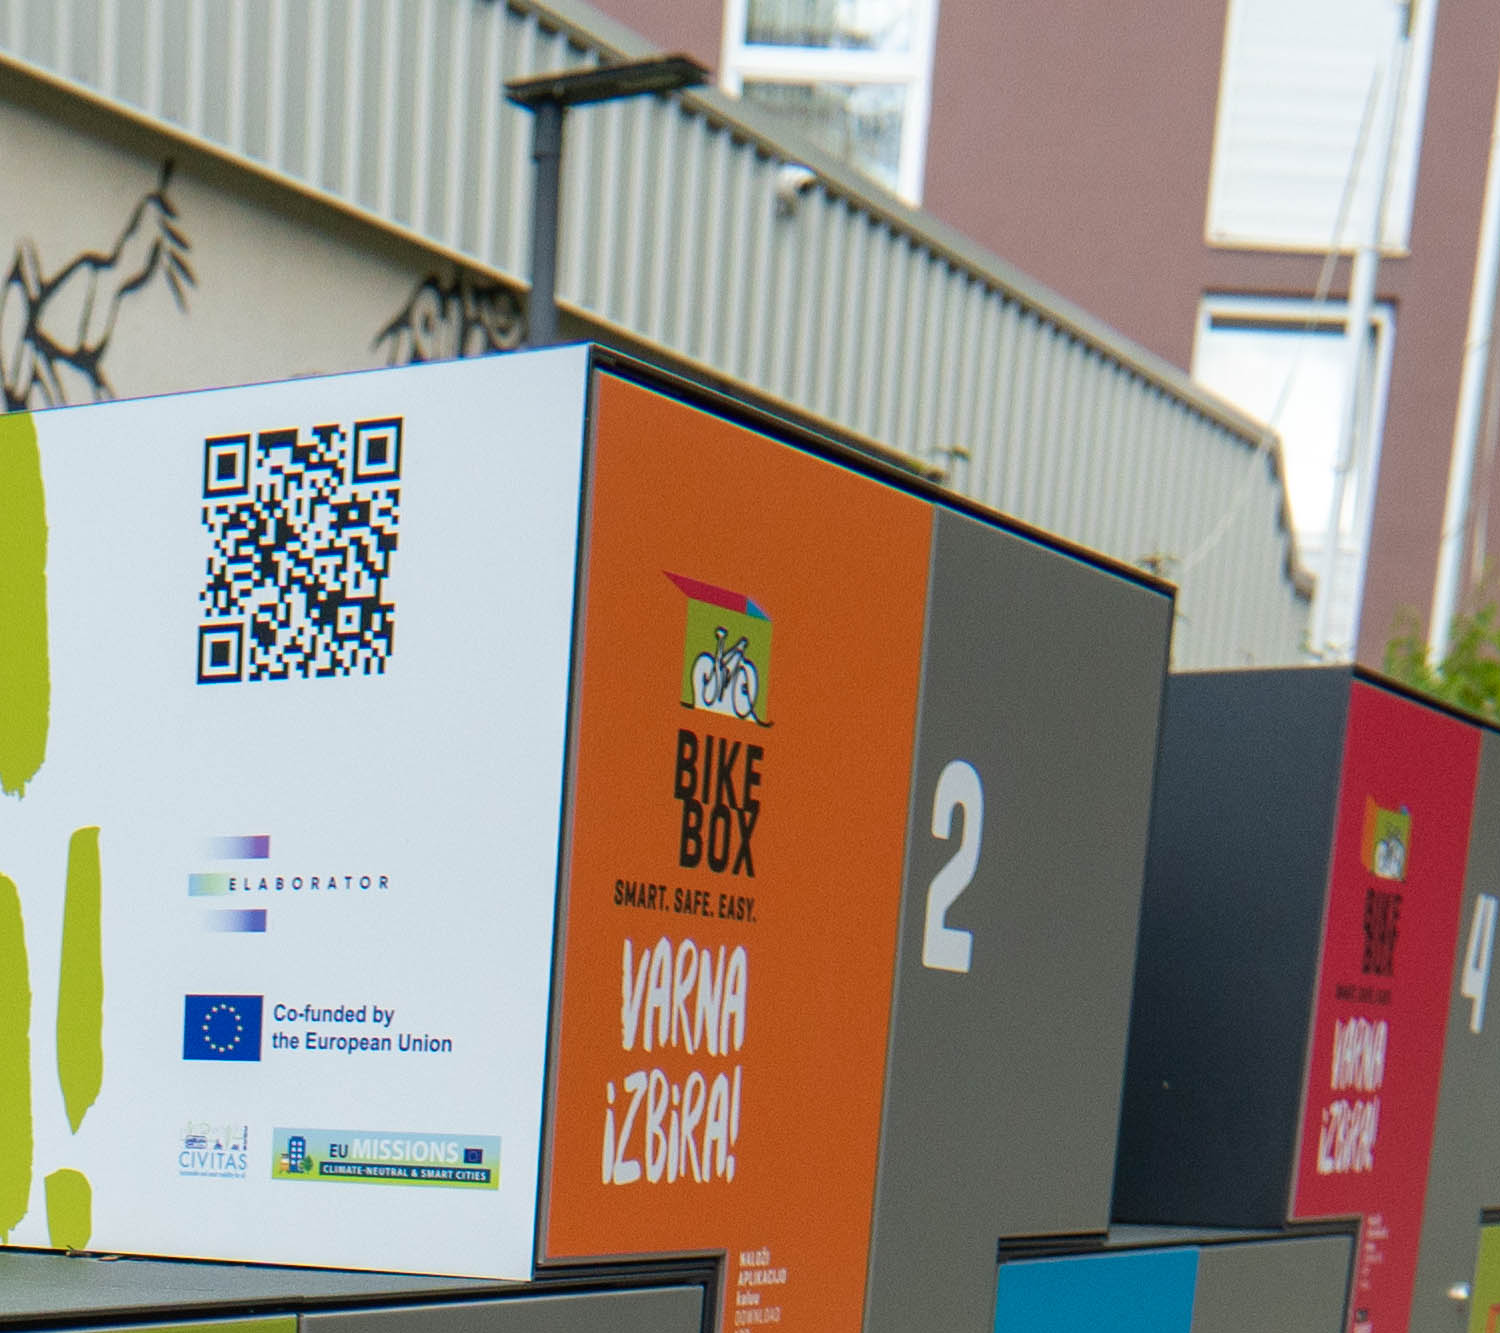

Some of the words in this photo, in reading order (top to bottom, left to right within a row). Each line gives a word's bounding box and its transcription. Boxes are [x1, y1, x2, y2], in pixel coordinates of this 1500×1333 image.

[673, 728, 765, 815] BIKE
[679, 799, 761, 878] BOX
[228, 875, 390, 891] ELABORATOR
[922, 759, 984, 973] 2
[613, 879, 670, 912] SMART.
[674, 887, 714, 917] SAFE.
[718, 893, 757, 923] EASY.
[1460, 893, 1499, 1035] 4
[273, 1003, 367, 1023] Co-funded
[372, 1004, 395, 1027] by
[621, 936, 748, 1057] VARNA
[271, 1031, 300, 1050] the
[305, 1032, 392, 1054] European
[398, 1033, 453, 1053] Union
[178, 1150, 248, 1171] CIVITAS
[329, 1143, 349, 1158] EU
[352, 1138, 459, 1163] MISSIONS
